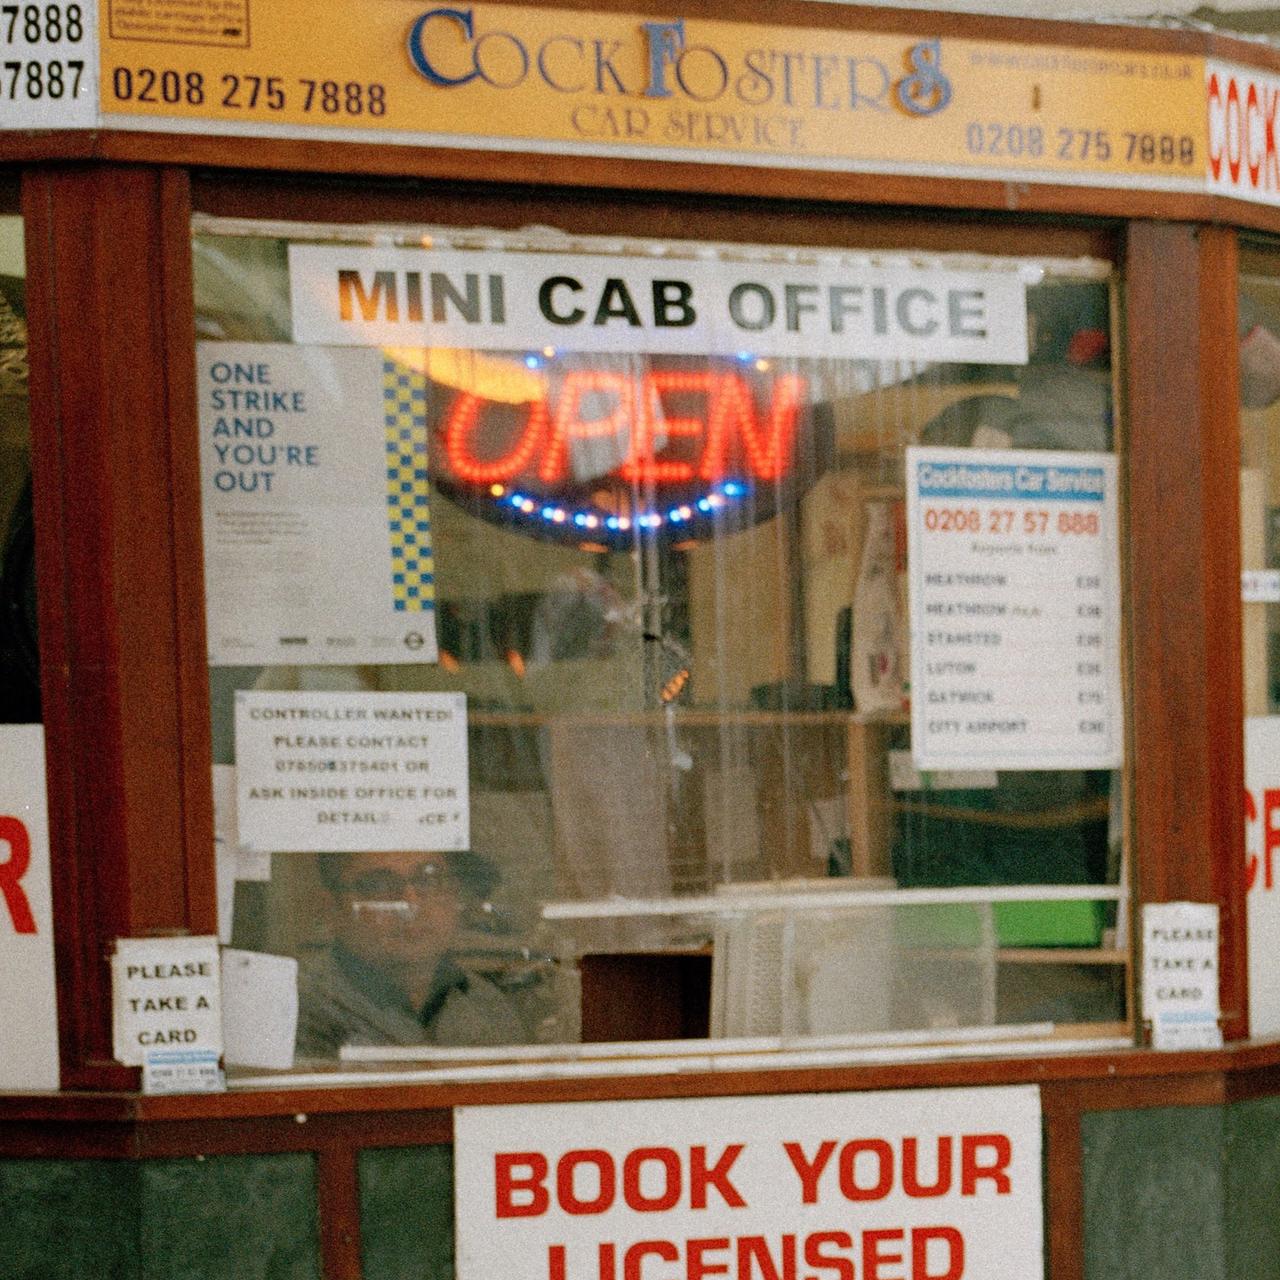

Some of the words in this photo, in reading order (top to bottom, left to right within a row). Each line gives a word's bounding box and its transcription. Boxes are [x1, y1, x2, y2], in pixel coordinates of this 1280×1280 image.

[2, 4, 83, 44] 7888
[4, 60, 84, 100] 7887
[113, 67, 205, 104] 0208
[222, 74, 286, 111] 275
[301, 79, 387, 117] 7888
[571, 105, 650, 138] CAR
[667, 109, 805, 150] SERVICE
[966, 122, 1044, 157] 0208
[1058, 127, 1111, 163] 275
[1125, 132, 1194, 166] 7888
[337, 268, 508, 327] MINI
[537, 275, 699, 330] CAB
[727, 282, 989, 339] OFFICE
[210, 361, 270, 384] ONE
[210, 390, 307, 413] STRIKE
[212, 417, 274, 439] AND
[445, 370, 806, 484] OPEN
[213, 444, 319, 467] YOU'RE
[214, 471, 275, 493] OUT
[1015, 466, 1044, 491] Car
[924, 507, 981, 532] 0208
[988, 509, 1014, 534] 27
[1023, 510, 1050, 534] 57
[1057, 511, 1099, 536] 888
[925, 574, 1007, 586] HEATHROW
[925, 603, 1007, 615] HEATHROW
[927, 662, 976, 675] LUTON
[250, 708, 368, 721] CONTROLLER
[928, 720, 960, 733] CITY
[966, 719, 1027, 733] AIRPORT
[274, 735, 339, 748] PLEASE
[347, 735, 429, 748] CONTACT
[406, 760, 429, 772] OR
[249, 787, 284, 800] ASK
[291, 787, 348, 800] INSIDE
[355, 787, 417, 800] OFFICE
[423, 787, 457, 799] FOR
[1152, 928, 1214, 942] PLEASE
[127, 962, 211, 979] PLEASE
[1152, 957, 1197, 970] TAKE
[1202, 958, 1214, 970] A
[128, 997, 188, 1012] TAKE
[195, 996, 210, 1010] A
[1157, 987, 1202, 1000] CARD
[137, 1028, 197, 1045] CARD
[494, 1143, 747, 1219] BOOK
[784, 1133, 1013, 1204] YOUR
